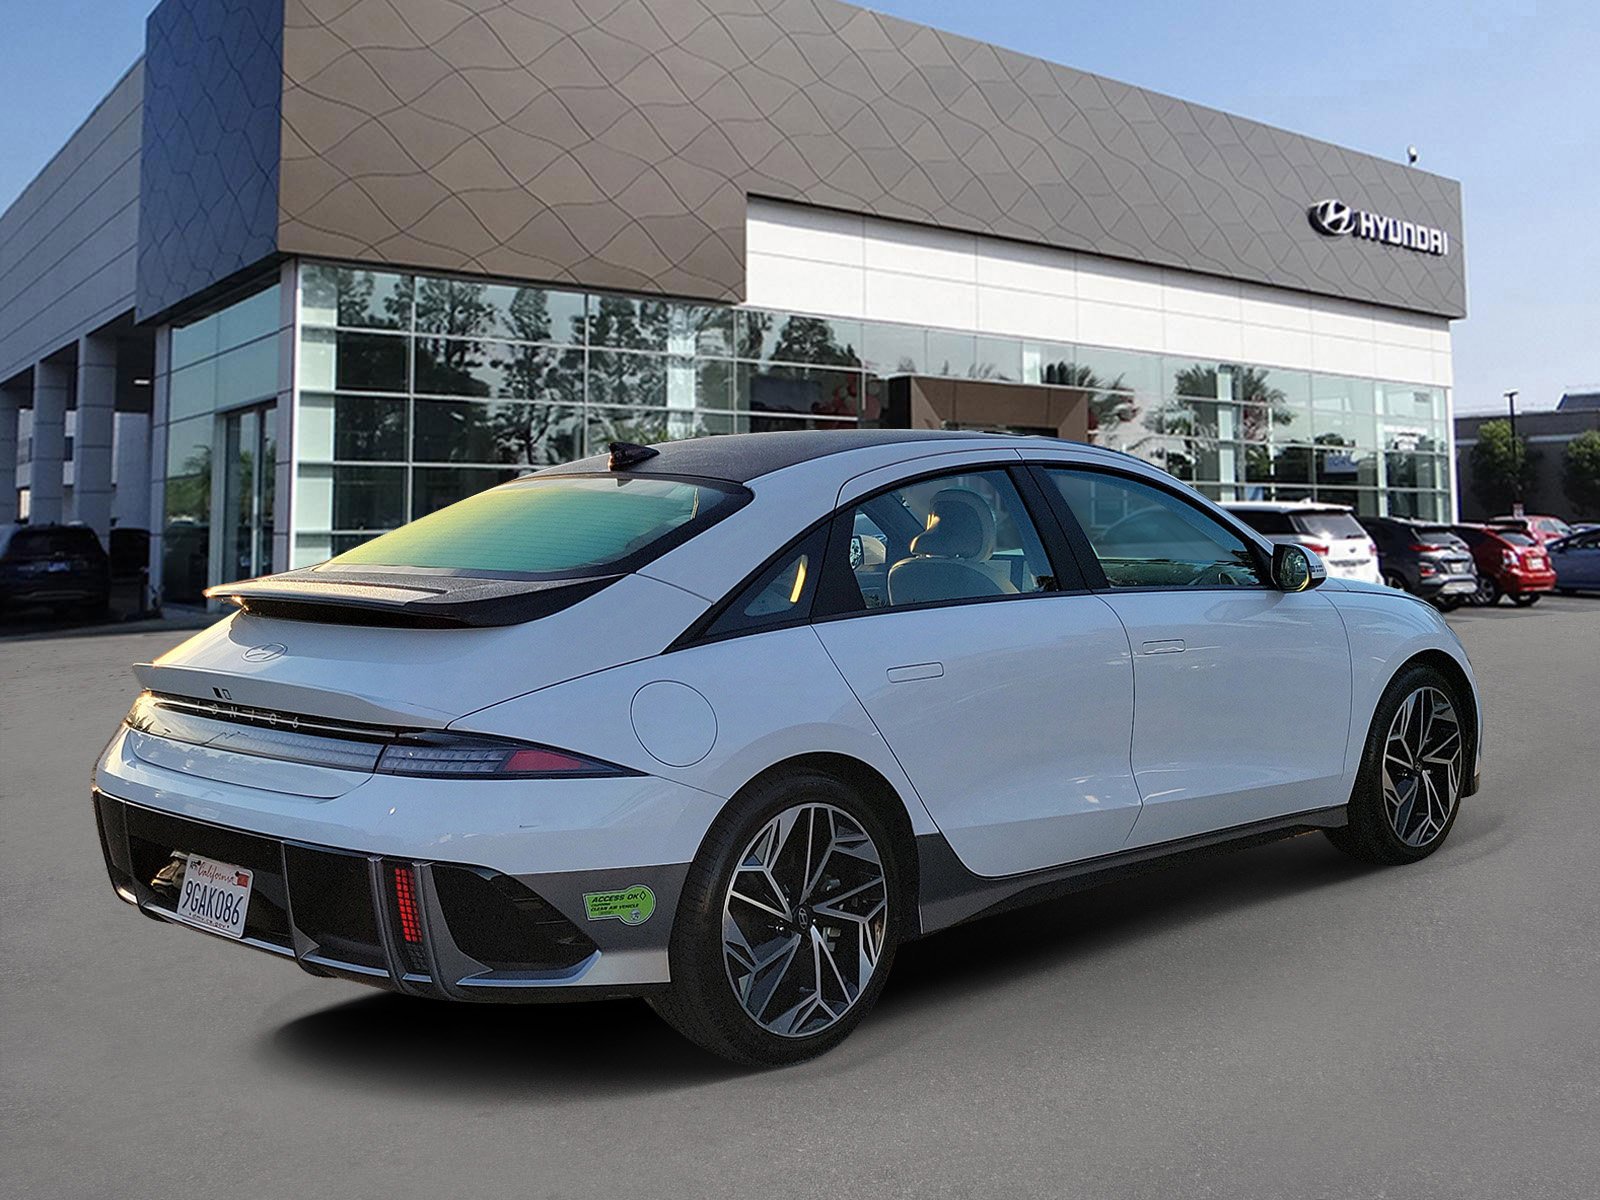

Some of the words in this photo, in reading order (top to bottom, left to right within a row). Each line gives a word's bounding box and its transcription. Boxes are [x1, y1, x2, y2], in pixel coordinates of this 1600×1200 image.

[1359, 210, 1449, 256] HYUNDAI
[197, 861, 235, 884] California
[181, 880, 244, 926] 9GAK086
[591, 894, 625, 903] ACCESS
[627, 892, 640, 901] OK
